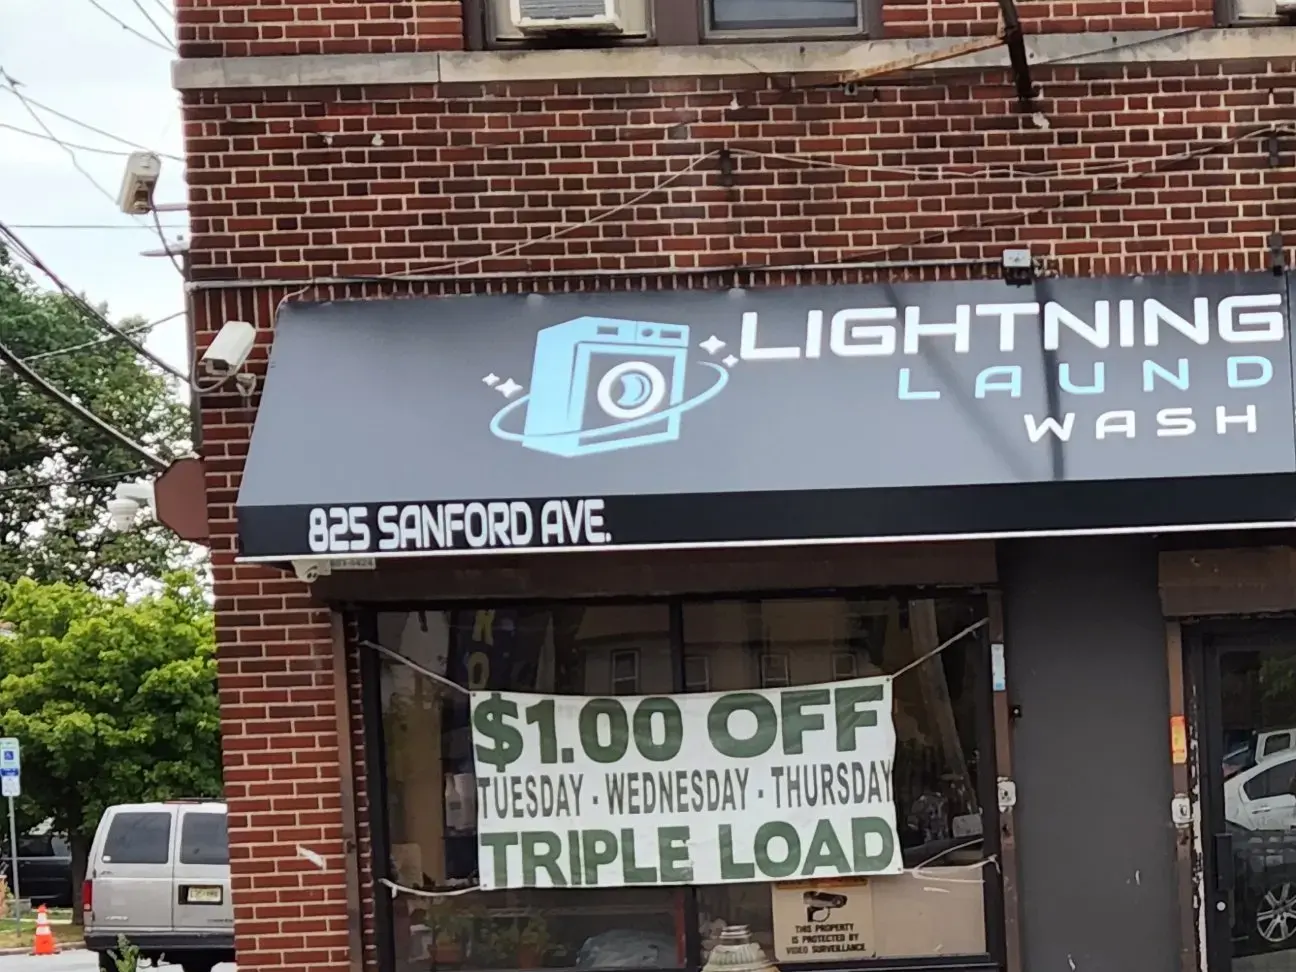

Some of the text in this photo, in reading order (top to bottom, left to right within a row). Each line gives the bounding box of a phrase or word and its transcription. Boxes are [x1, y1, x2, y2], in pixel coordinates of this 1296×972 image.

[740, 294, 1284, 360] LIGHTNING
[1023, 404, 1258, 443] WASH
[308, 498, 612, 552] 825 SANFORD AVE.
[473, 684, 885, 773] $1.00 OFF
[477, 773, 584, 819] TUESDAY
[605, 767, 750, 815] WEDNESDAY
[770, 760, 891, 809] THURSDAY
[480, 816, 895, 887] TRIPLE LOAD
[786, 943, 866, 954] VIDEO SURVEILLANCE
[791, 933, 859, 944] IS PROTECTED BY
[795, 923, 854, 933] THIS PROPERTY
